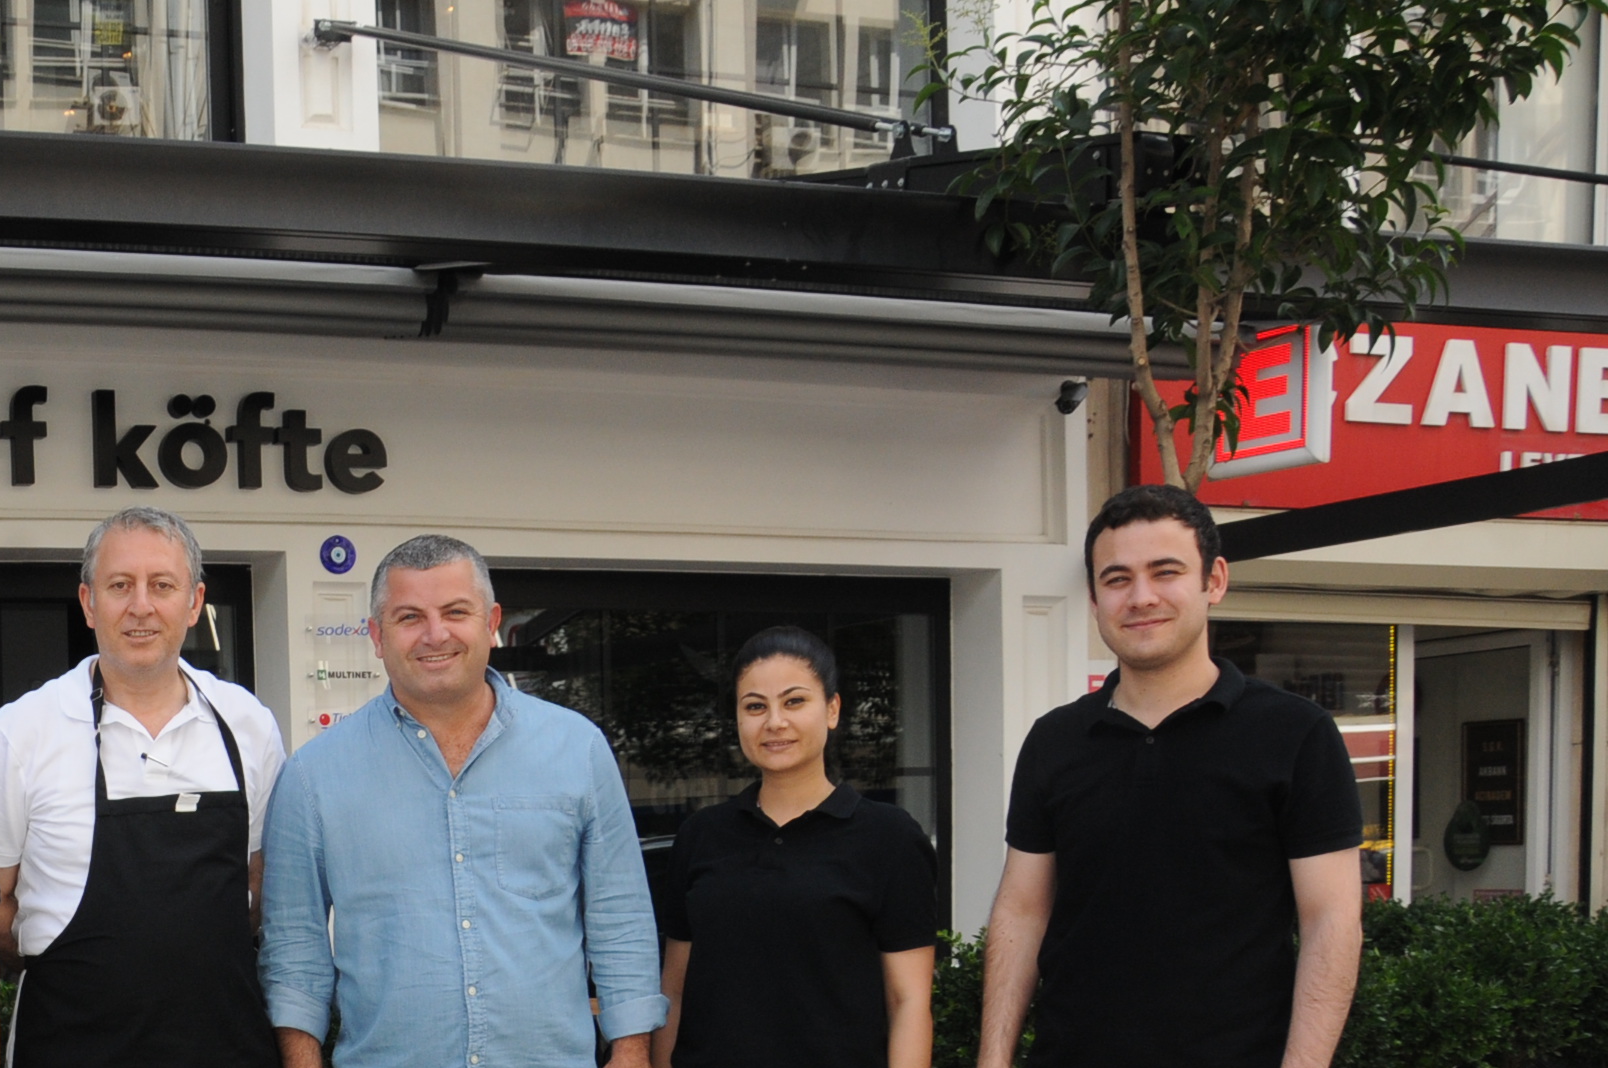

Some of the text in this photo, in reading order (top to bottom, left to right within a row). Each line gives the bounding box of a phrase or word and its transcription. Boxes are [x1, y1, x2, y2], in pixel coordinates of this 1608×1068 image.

[1329, 332, 1608, 434] ZANE
[92, 389, 388, 494] köfte
[316, 622, 370, 636] sodexo
[328, 671, 372, 679] MULTINET
